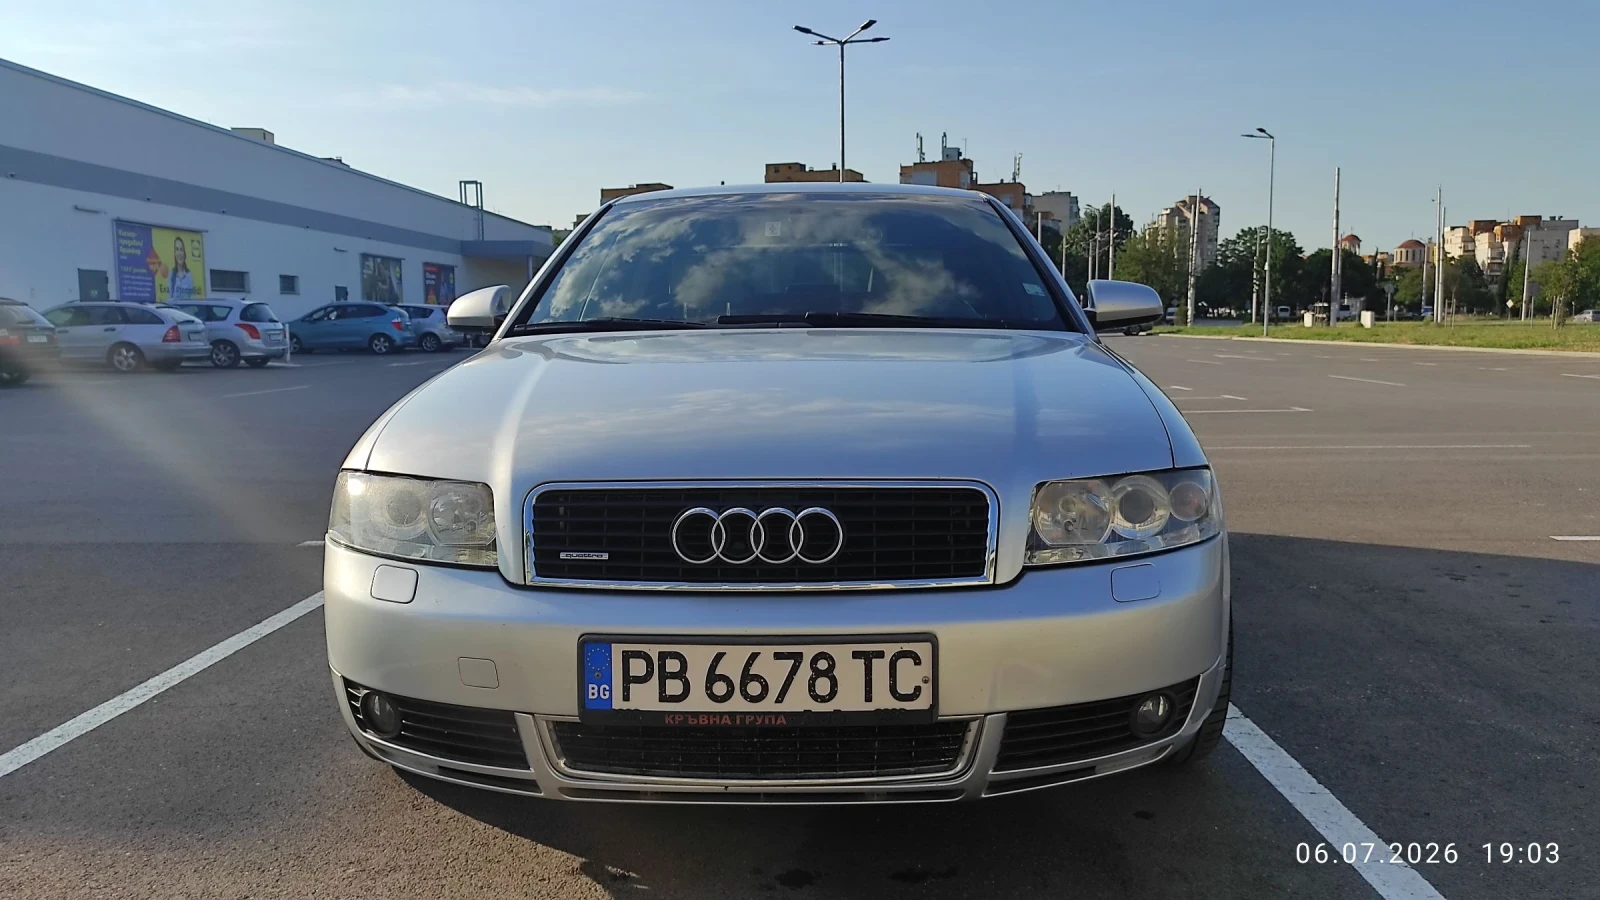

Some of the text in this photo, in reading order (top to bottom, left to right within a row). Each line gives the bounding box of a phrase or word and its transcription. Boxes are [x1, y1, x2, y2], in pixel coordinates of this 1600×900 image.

[622, 650, 923, 704] PB 6678 TC
[588, 683, 610, 700] BG
[664, 713, 787, 726] КРЪВНА ГРУПА
